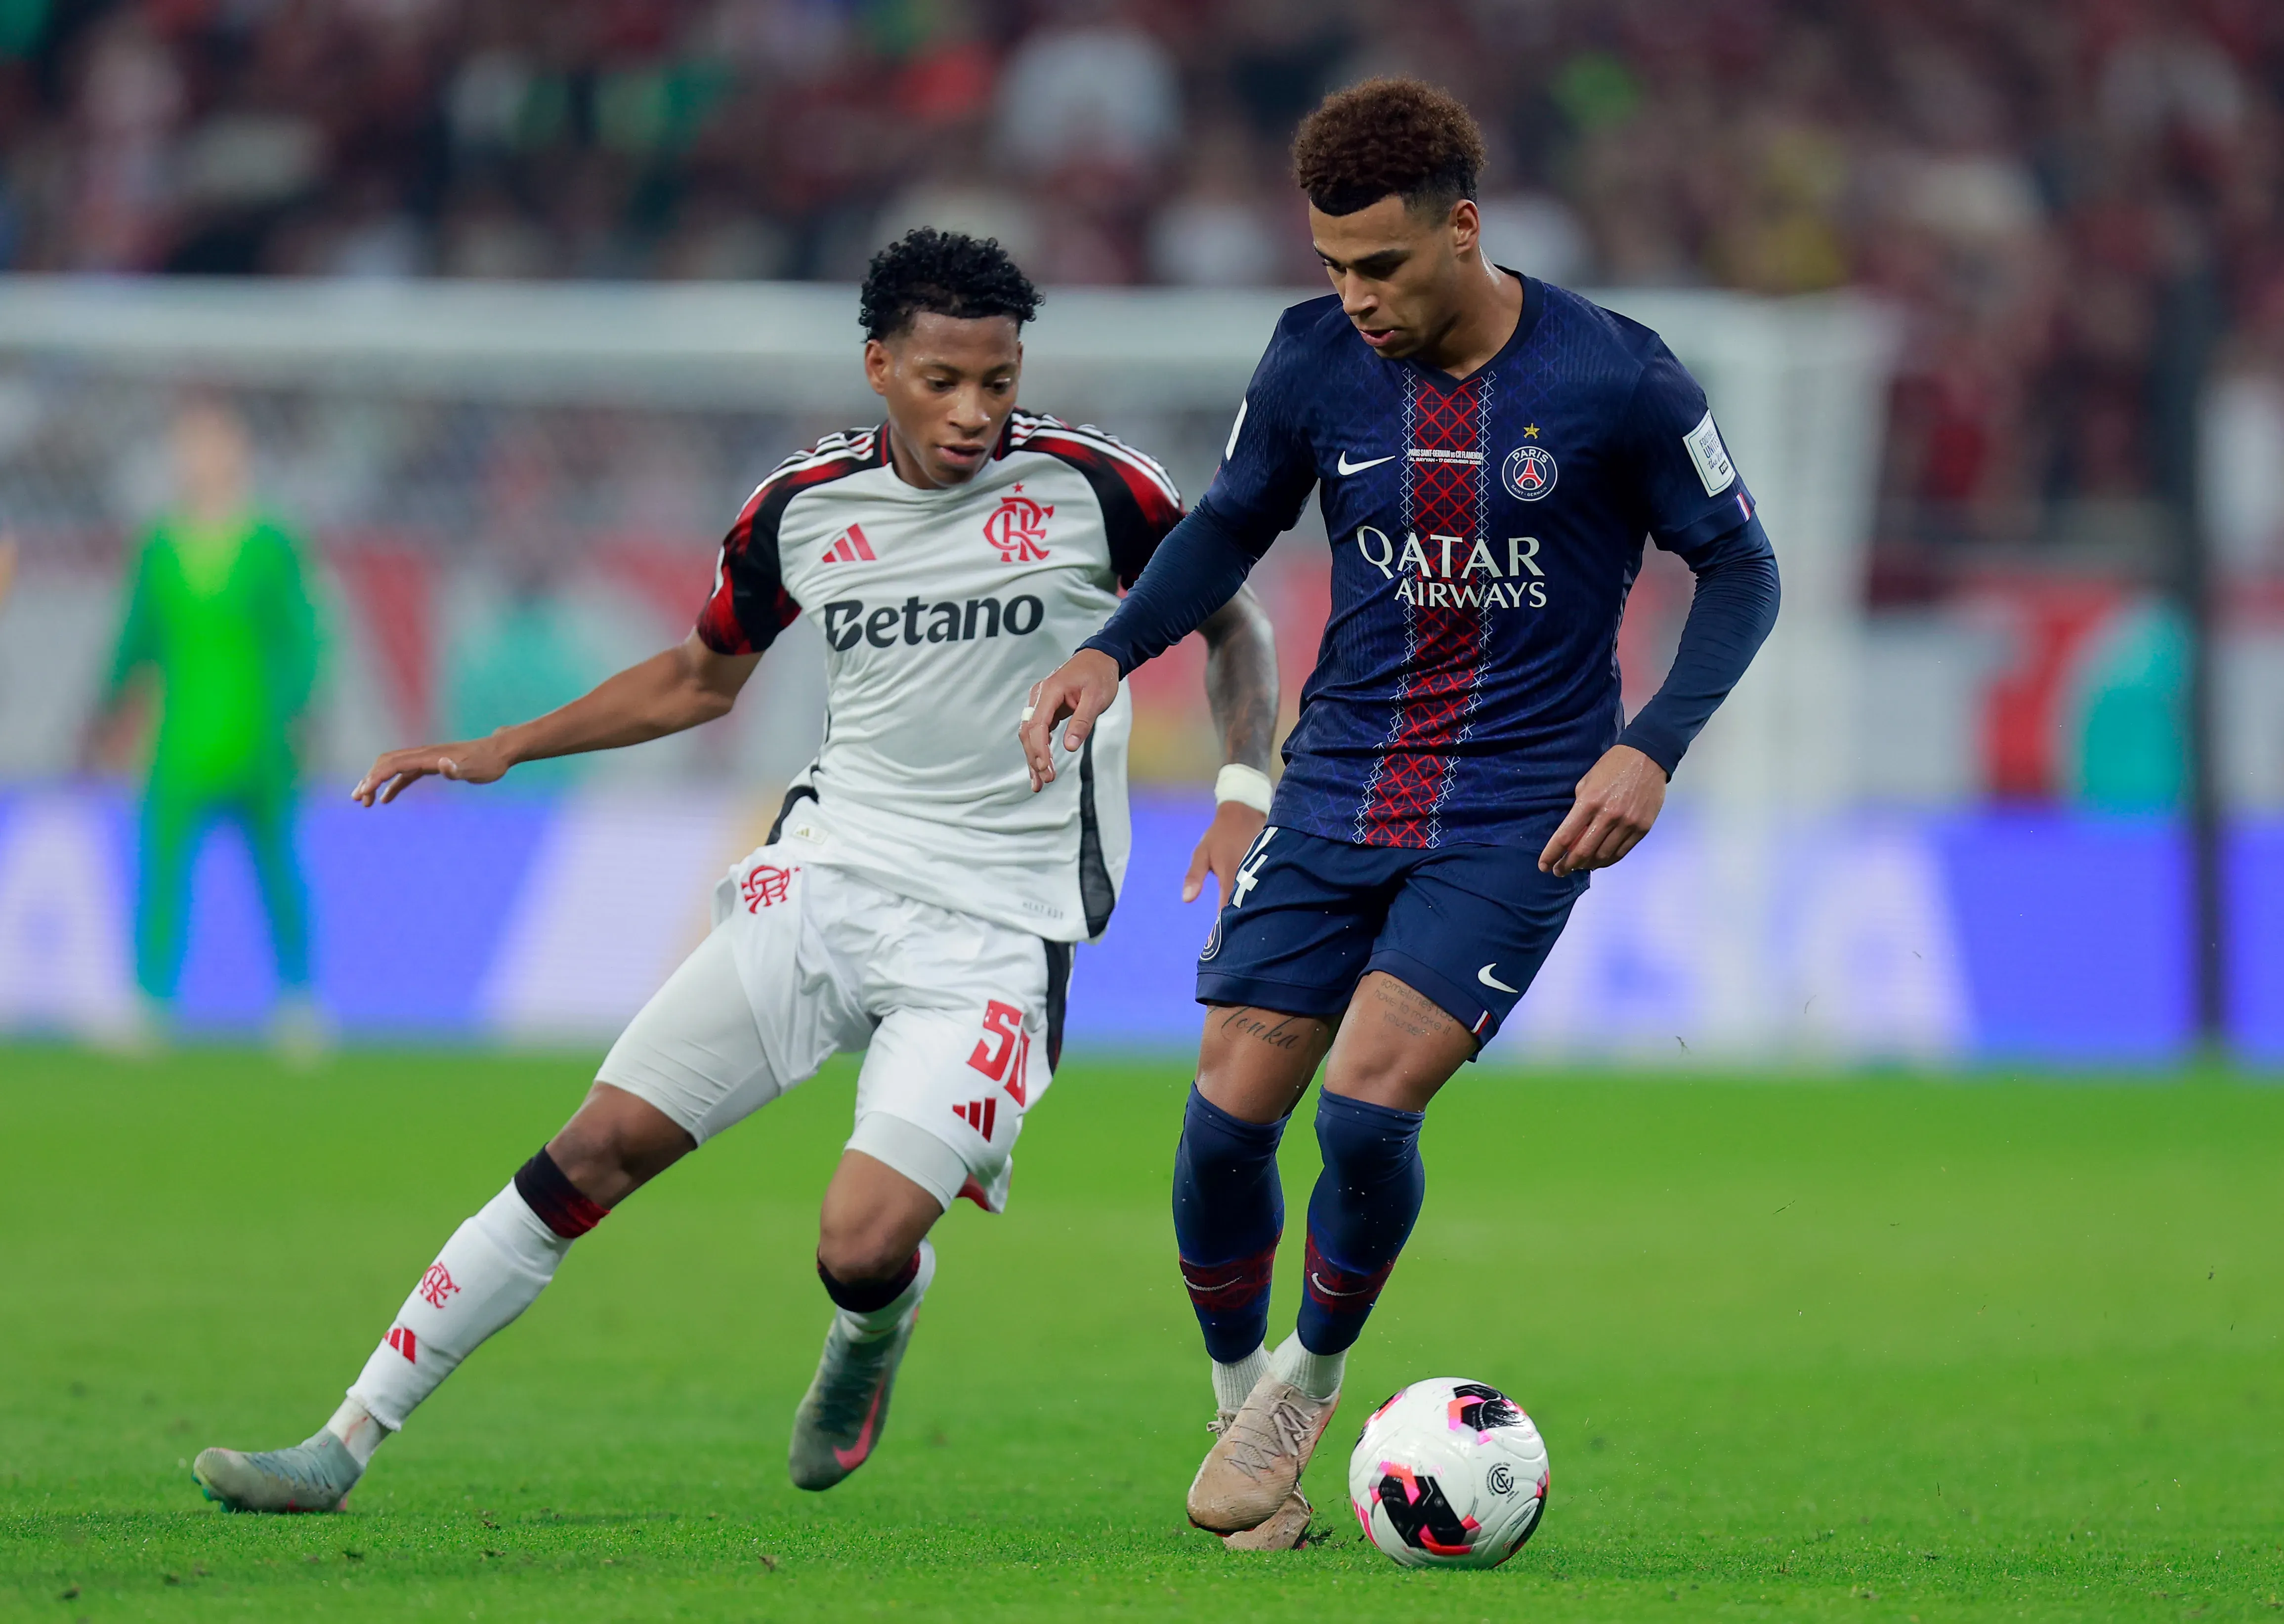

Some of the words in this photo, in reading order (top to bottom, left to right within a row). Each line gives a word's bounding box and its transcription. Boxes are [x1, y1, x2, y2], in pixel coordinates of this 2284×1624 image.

[1462, 451, 1482, 460] FLAMENGO
[1512, 449, 1549, 463] PARIS
[1356, 526, 1545, 580] QATAR
[1394, 578, 1547, 608] AIRWAYS
[824, 595, 1044, 652] Betano
